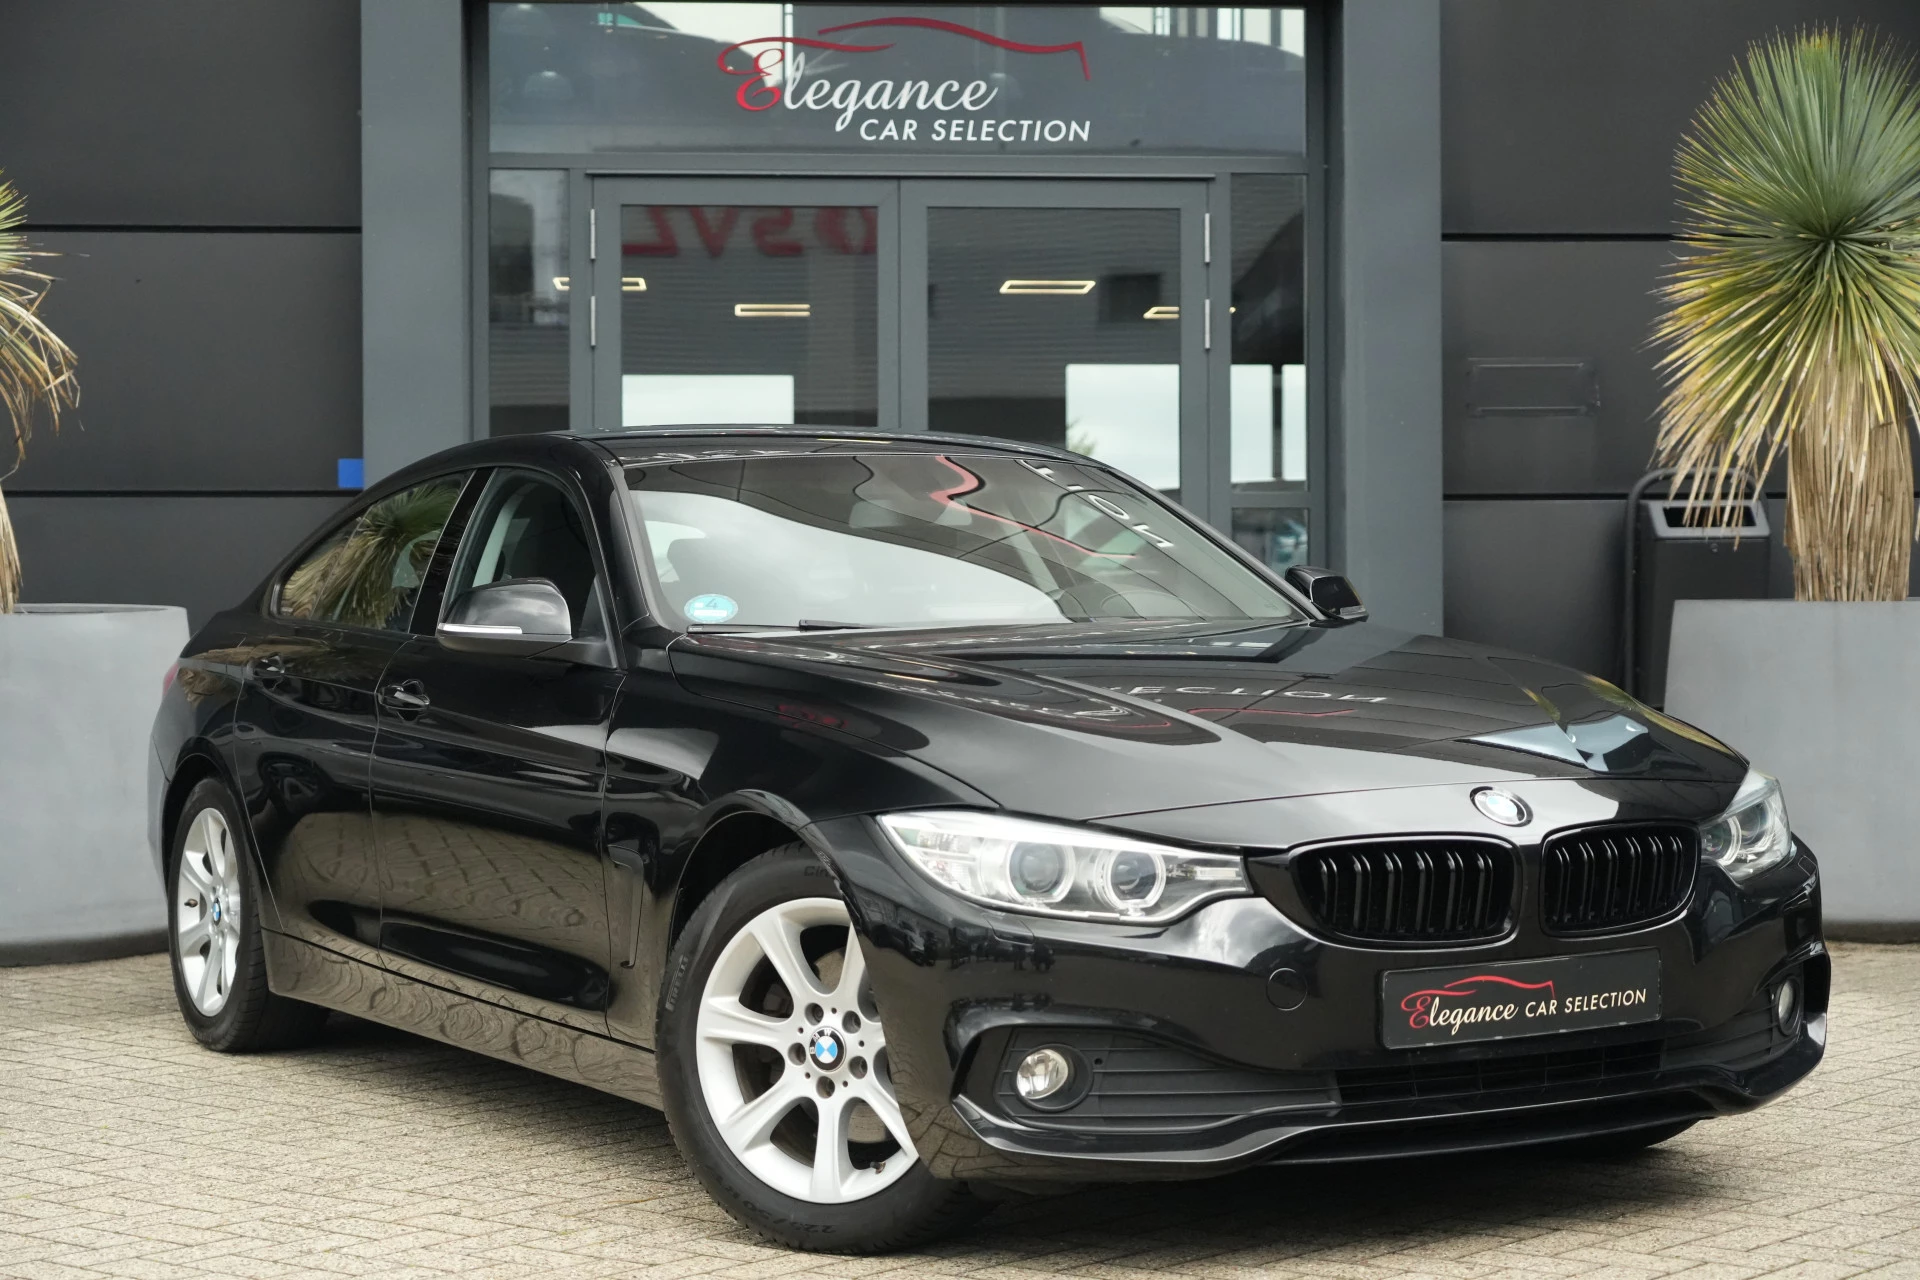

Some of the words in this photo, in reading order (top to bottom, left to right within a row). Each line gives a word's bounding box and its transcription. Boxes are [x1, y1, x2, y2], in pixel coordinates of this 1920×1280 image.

[717, 42, 998, 132] Elegance
[860, 118, 917, 141] CAR
[931, 119, 1090, 142] SELECTION
[705, 598, 719, 610] 4
[1401, 992, 1519, 1036] Elegance
[1525, 1000, 1557, 1018] CAR
[1564, 988, 1647, 1014] SELECTION
